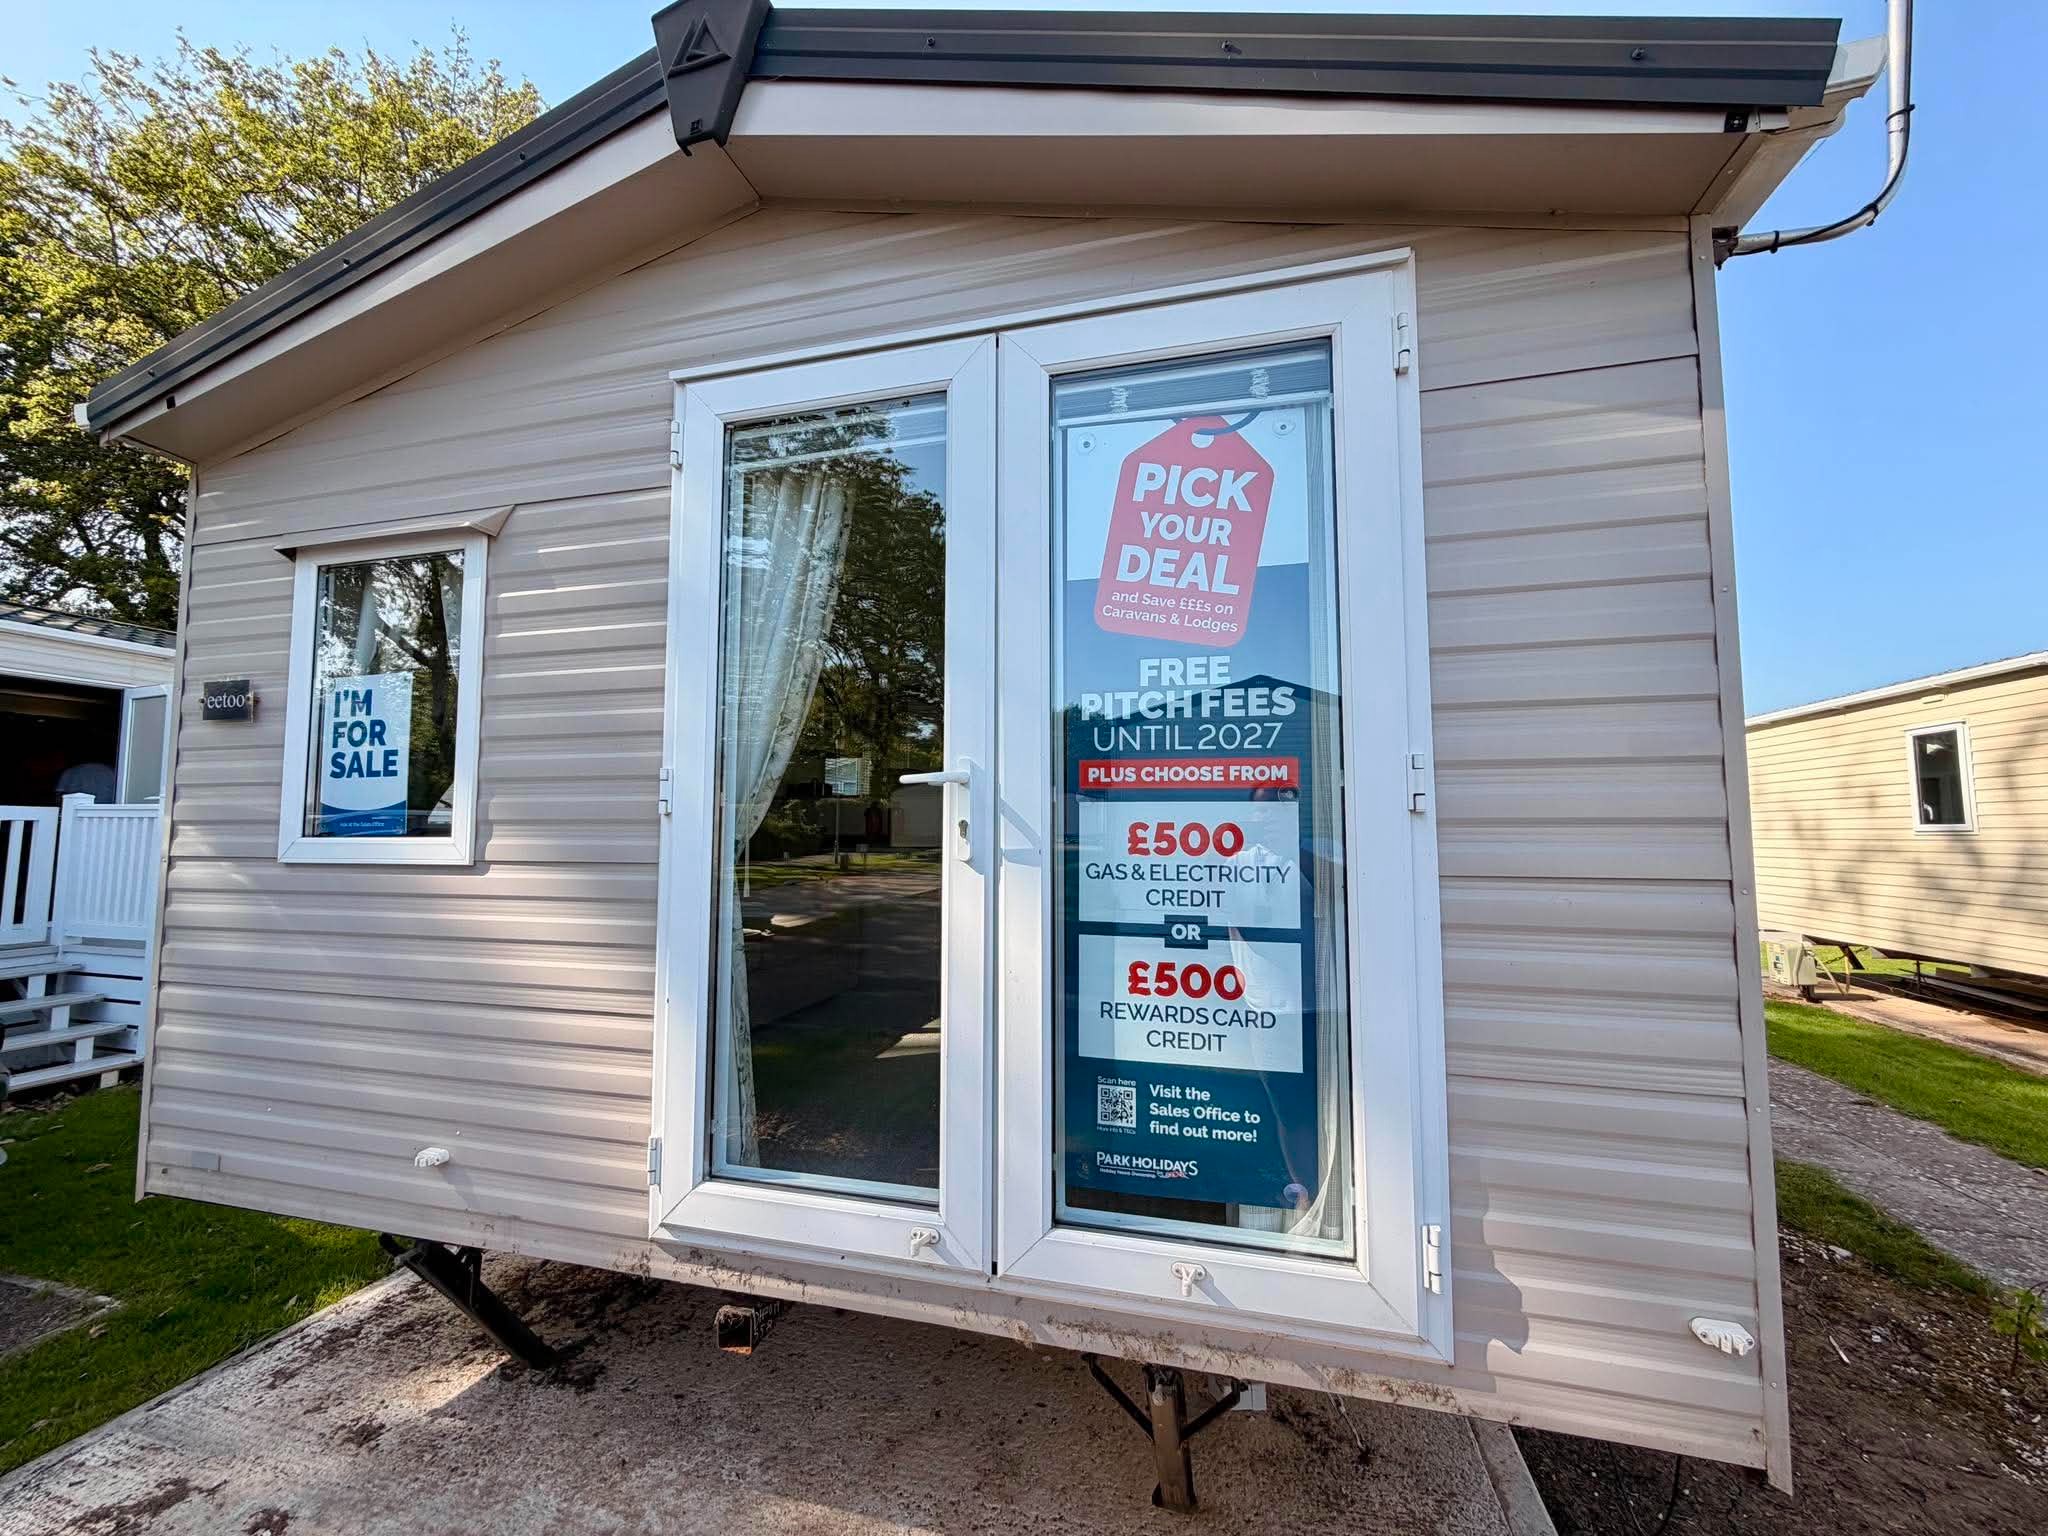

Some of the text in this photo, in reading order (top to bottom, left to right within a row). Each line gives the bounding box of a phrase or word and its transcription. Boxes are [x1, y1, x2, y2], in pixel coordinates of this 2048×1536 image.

[1131, 462, 1258, 512] PICK
[1141, 512, 1232, 546] YOUR
[1115, 544, 1240, 596] DEAL
[1111, 591, 1233, 614] and Save £££s on
[1102, 605, 1239, 633] Caravans & Lodges
[1139, 655, 1231, 687] FREE
[207, 692, 245, 708] eetoo
[334, 688, 373, 718] I'M
[1080, 686, 1296, 720] PITCH FEES
[332, 719, 386, 749] FOR
[1093, 722, 1283, 752] UNTIL 2027
[329, 749, 398, 778] SALE
[1088, 764, 1288, 782] PLUS CHOOSE FROM
[1127, 821, 1245, 857] £500
[1086, 863, 1291, 884] GAS & ELECTRICITY
[1145, 888, 1226, 908] CREDIT
[1171, 923, 1201, 941] OR
[1127, 960, 1246, 1001] £500
[1101, 1001, 1276, 1030] REWARDS CARD
[1146, 1030, 1227, 1052] CREDIT
[1097, 1075, 1137, 1087] Scan here
[1149, 1084, 1210, 1101] Visit the
[1149, 1102, 1261, 1124] Sales Office to
[1149, 1121, 1179, 1136] find
[1182, 1123, 1209, 1139] out
[1212, 1127, 1258, 1143] more!
[1096, 1151, 1130, 1167] PARK
[1132, 1156, 1199, 1176] HOLIDAYS
